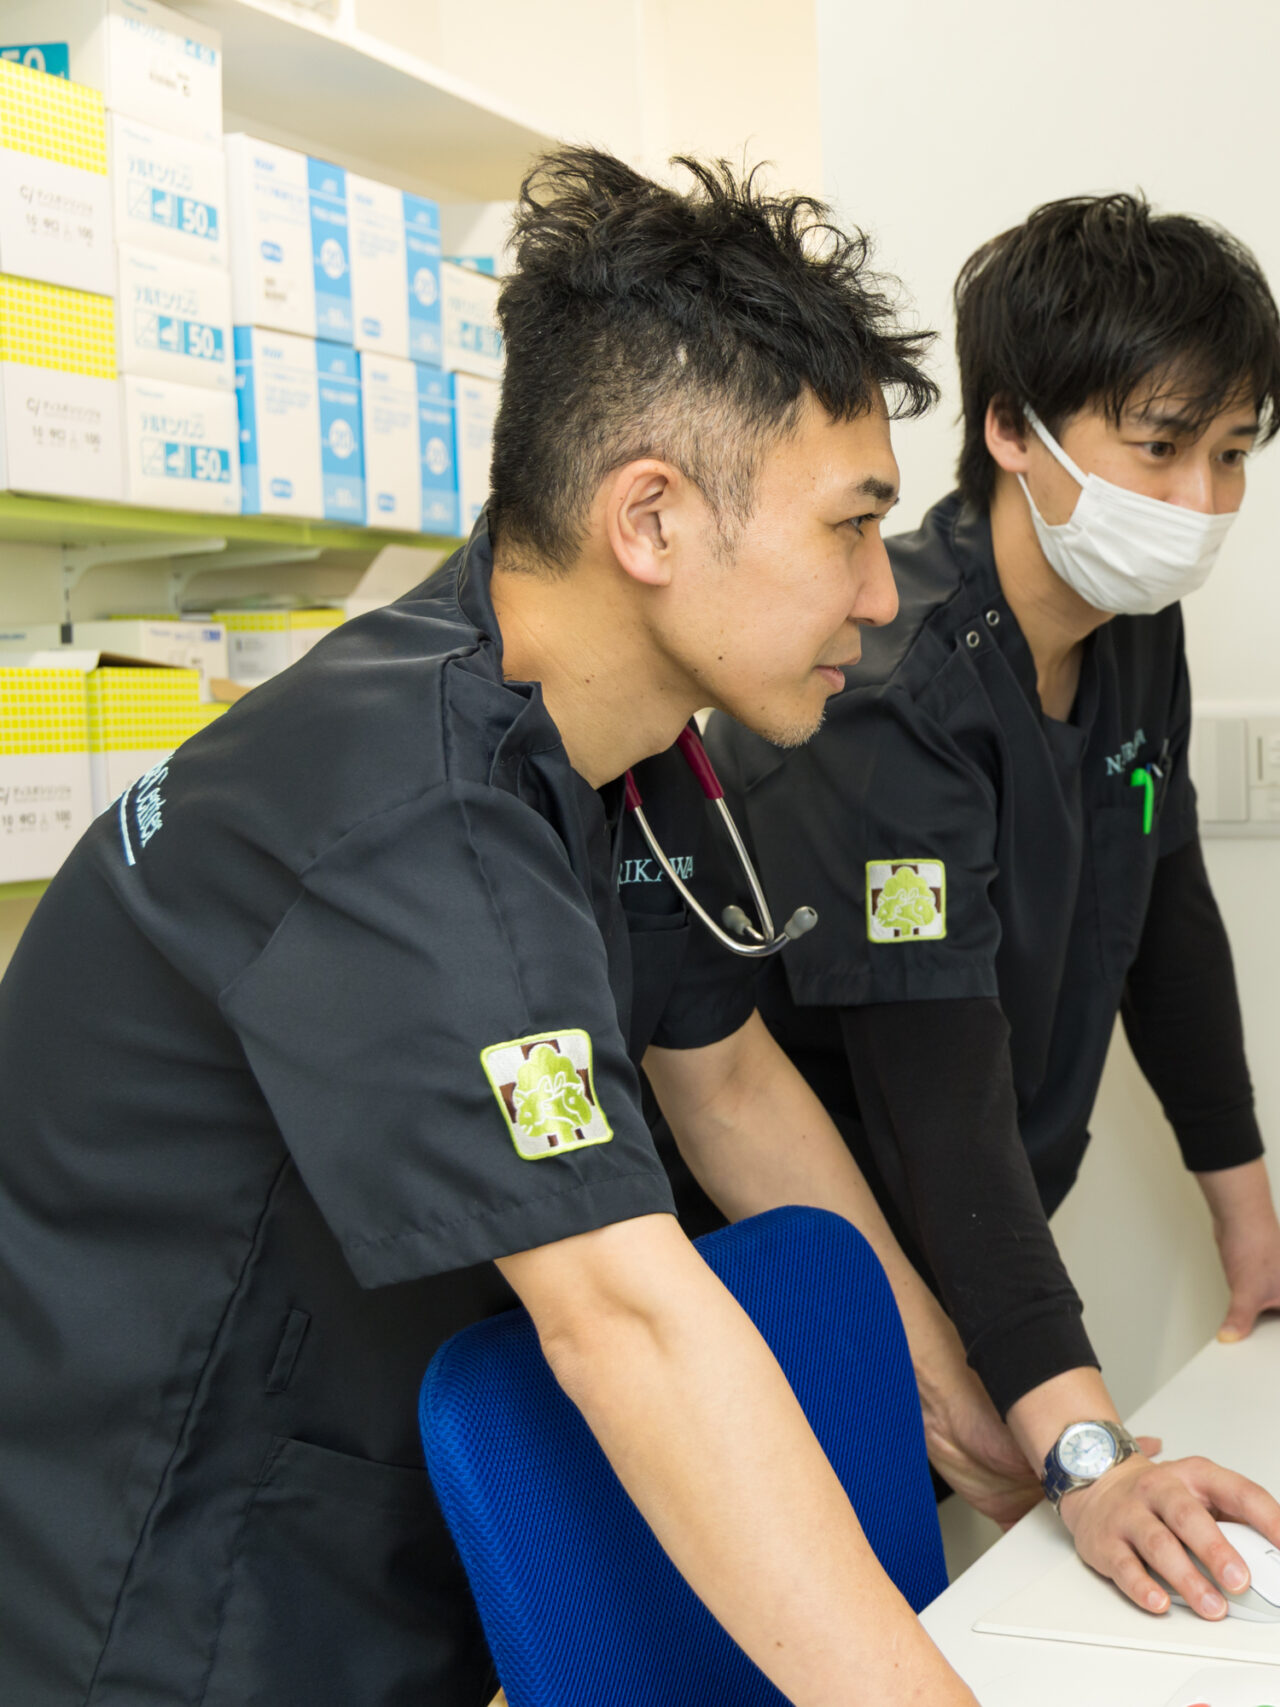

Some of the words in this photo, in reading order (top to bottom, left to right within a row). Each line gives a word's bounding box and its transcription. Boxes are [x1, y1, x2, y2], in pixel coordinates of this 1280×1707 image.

[183, 200, 208, 236] 50
[189, 323, 215, 359] 50
[195, 448, 221, 481] 50
